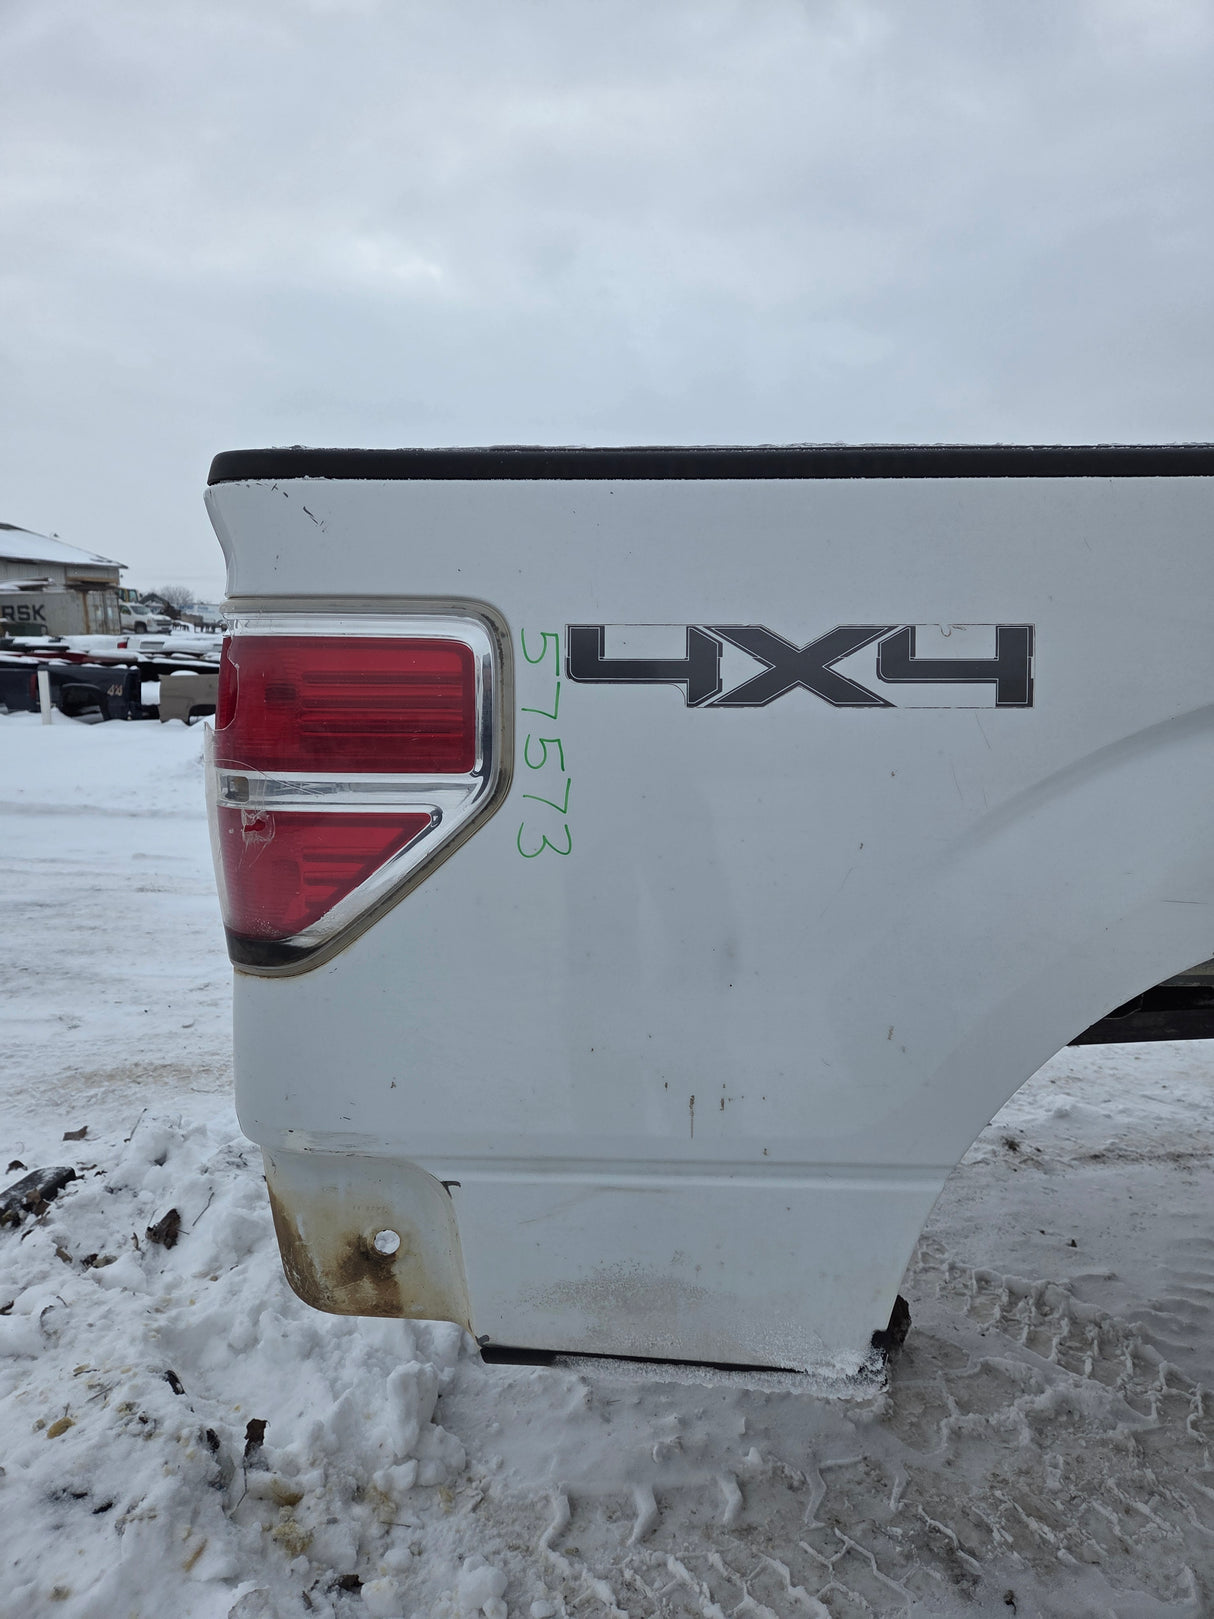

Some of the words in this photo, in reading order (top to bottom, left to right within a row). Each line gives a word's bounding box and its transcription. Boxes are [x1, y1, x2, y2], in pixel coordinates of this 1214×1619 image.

[1, 604, 46, 621] RSK
[567, 624, 1034, 708] 4X4
[517, 627, 572, 858] 57573
